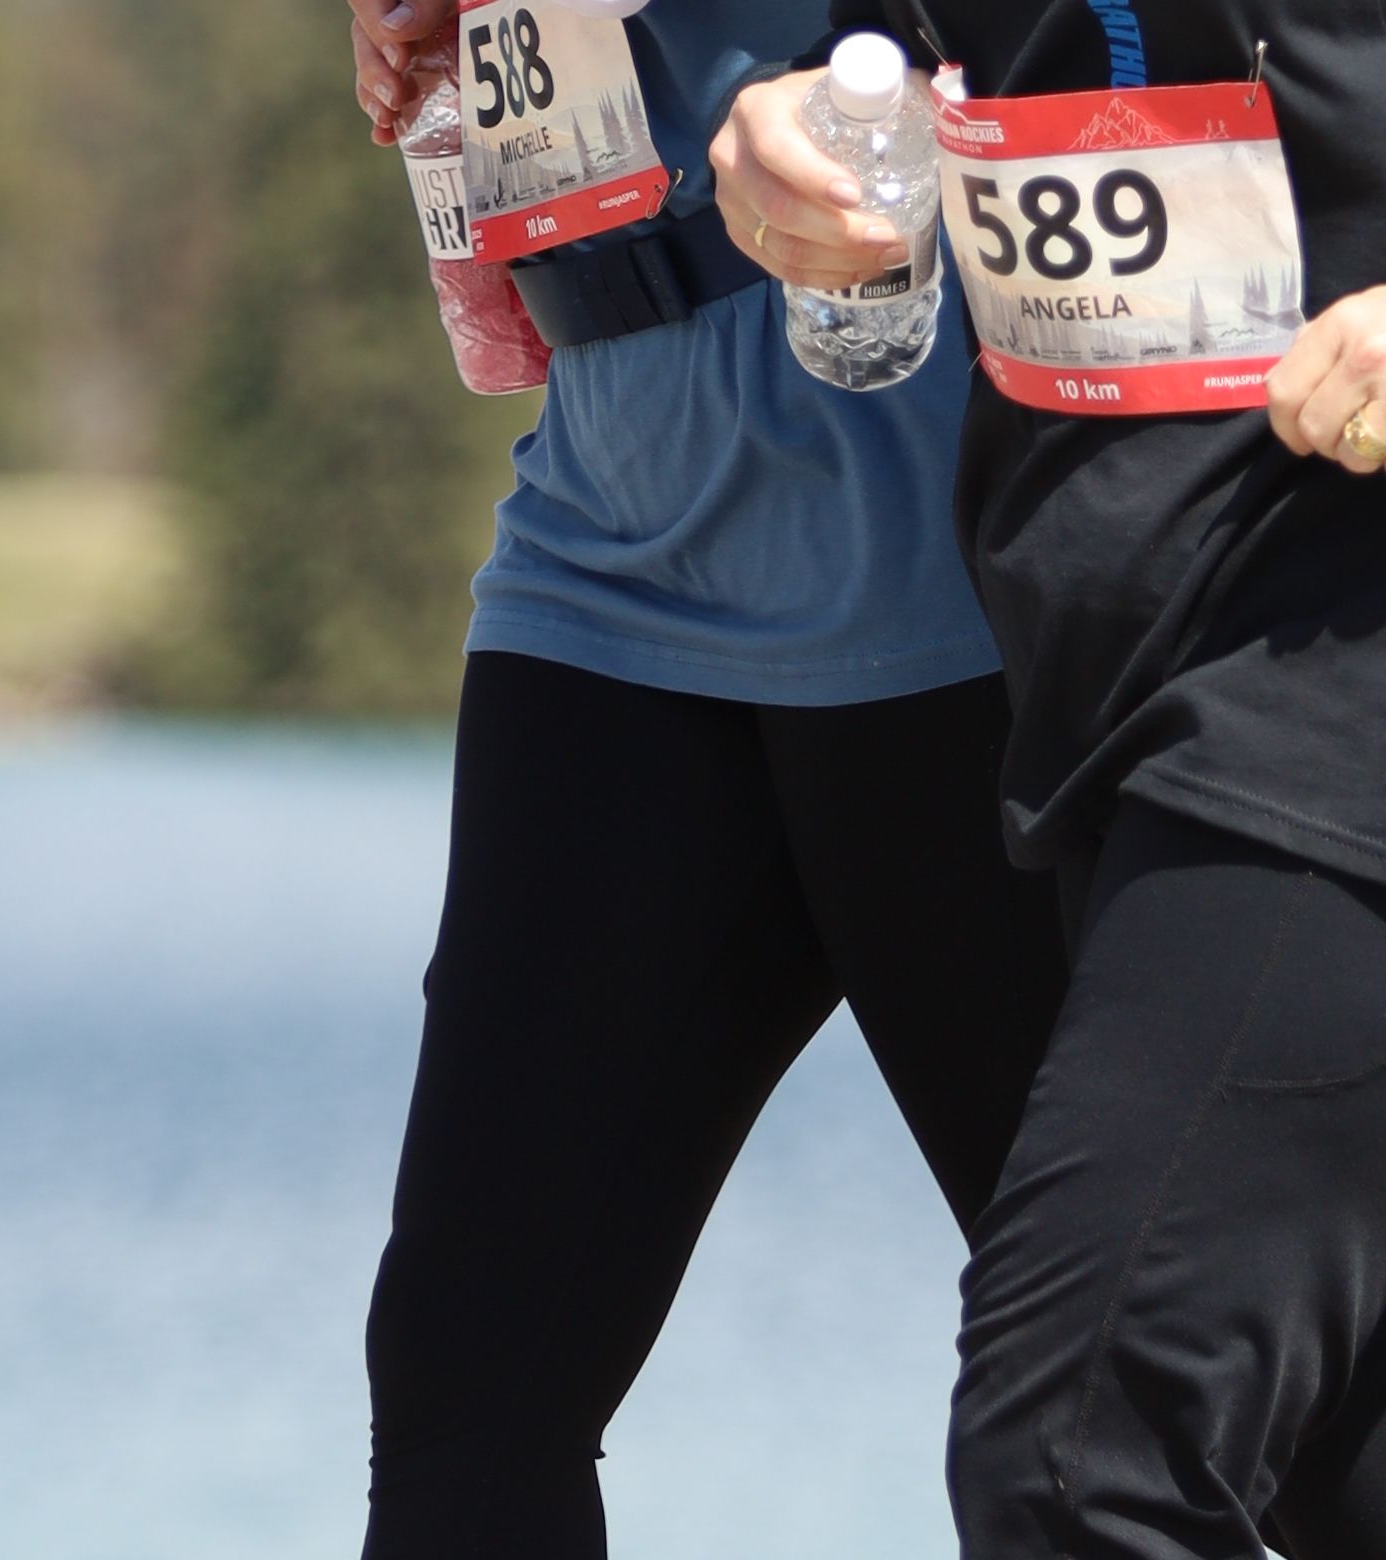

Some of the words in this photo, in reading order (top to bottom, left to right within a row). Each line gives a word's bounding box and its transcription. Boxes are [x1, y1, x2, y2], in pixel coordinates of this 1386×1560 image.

[468, 8, 554, 129] 588
[499, 126, 553, 166] MICHELLE
[959, 125, 1005, 144] ROCKIES
[525, 217, 537, 240] 10
[536, 215, 558, 236] km
[960, 168, 1168, 280] 589
[863, 280, 907, 298] HOMES
[1020, 294, 1132, 321] ANGELA
[1055, 378, 1079, 400] 10
[1082, 378, 1121, 400] km
